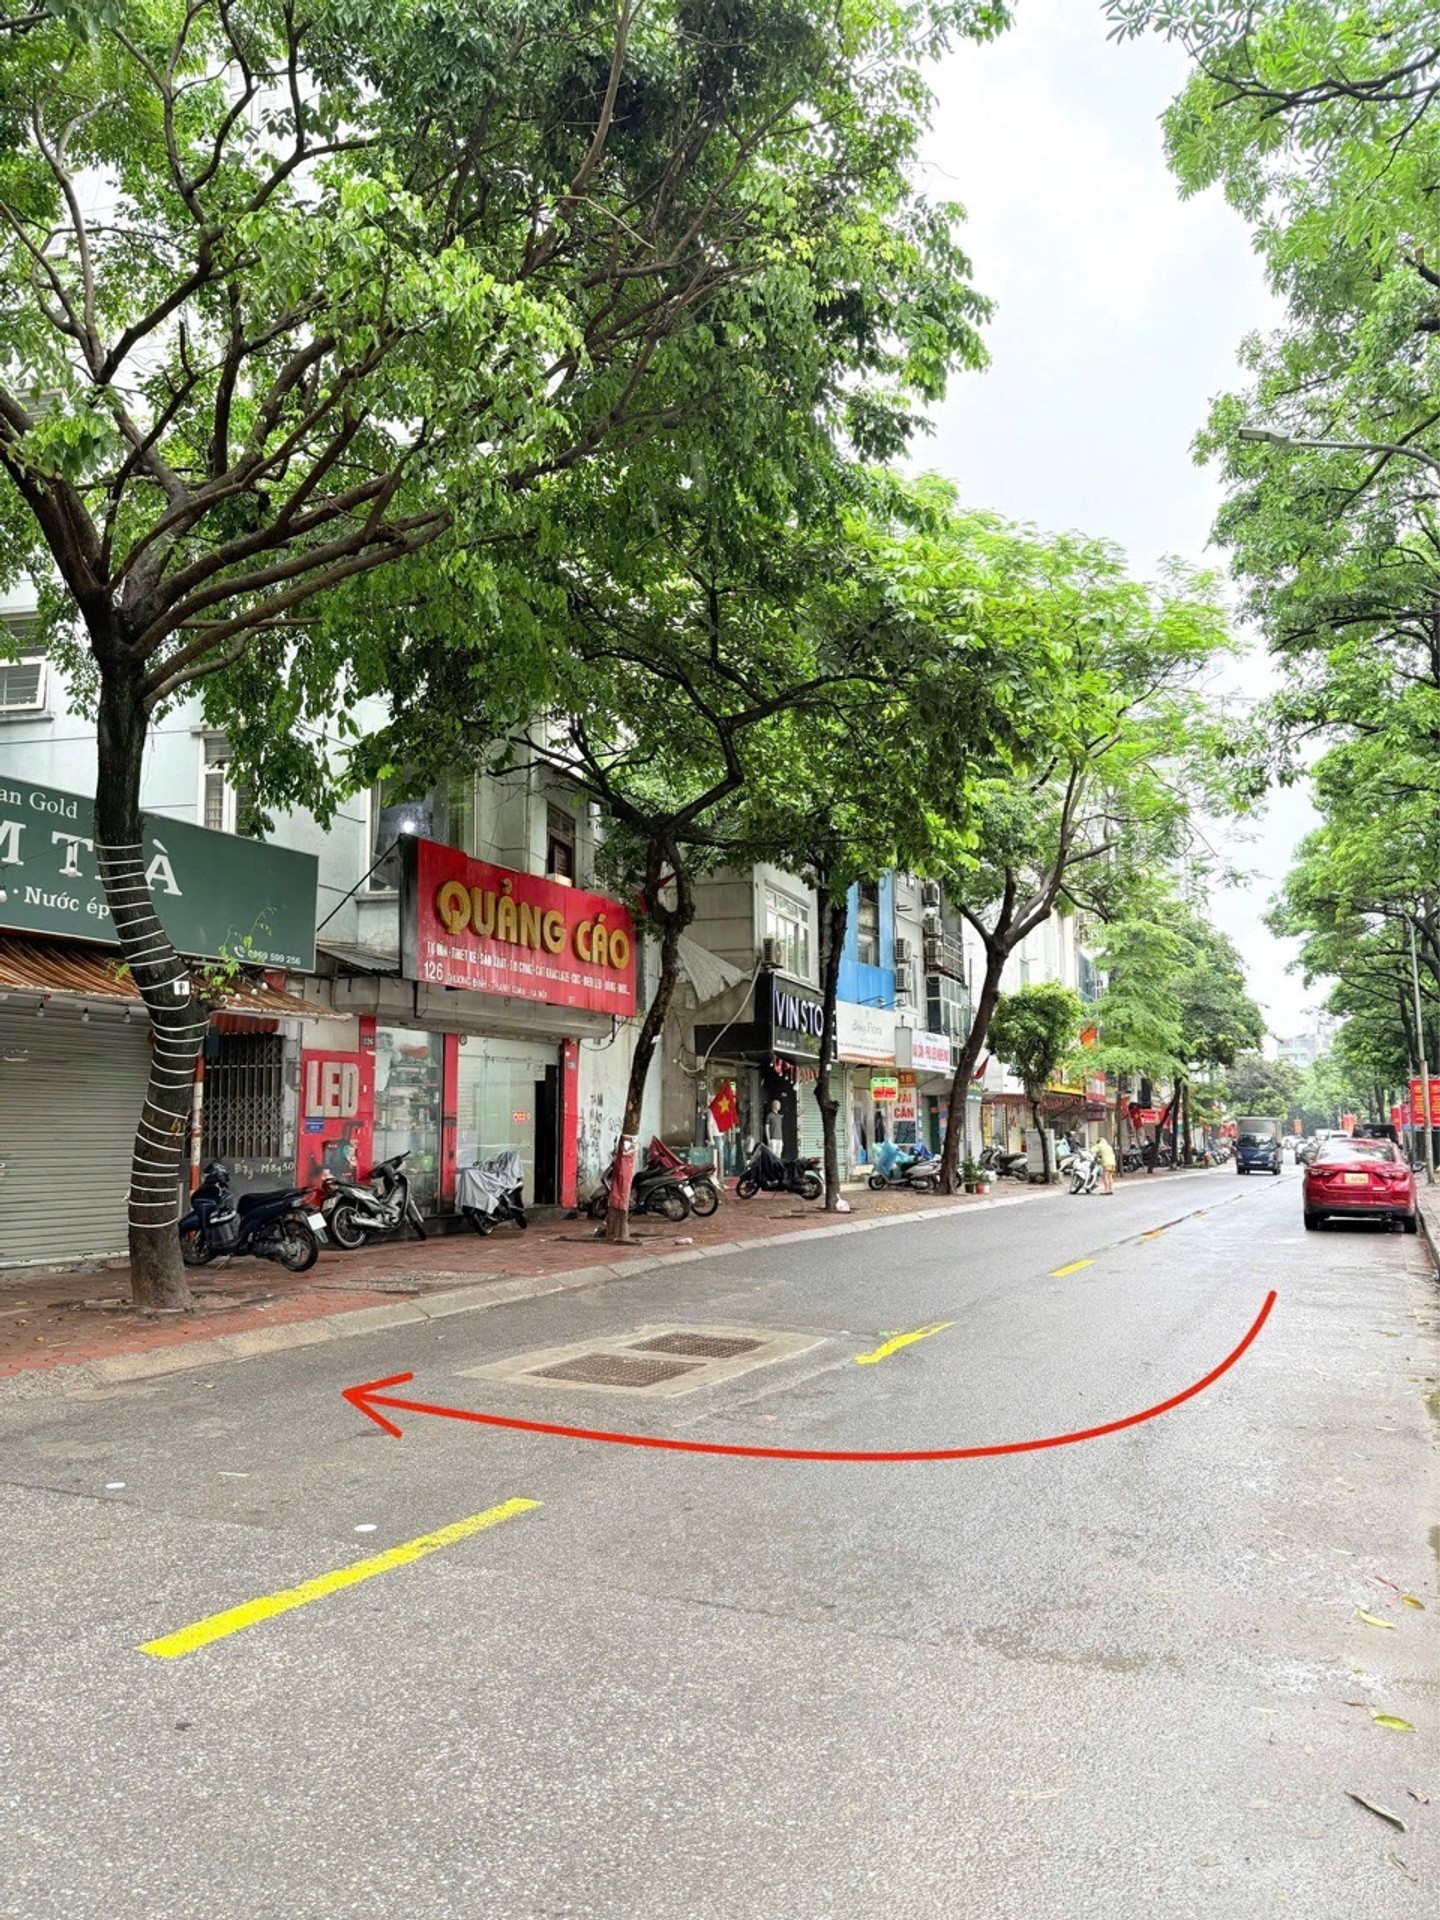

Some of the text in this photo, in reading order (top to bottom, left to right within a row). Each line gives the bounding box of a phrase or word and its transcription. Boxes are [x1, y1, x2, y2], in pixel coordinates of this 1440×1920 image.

[29, 791, 78, 819] Gold
[51, 830, 183, 897] TÀ
[24, 885, 110, 920] Nước ép
[437, 878, 630, 970] QUẢNG CÁO
[423, 960, 444, 982] 126
[775, 990, 799, 1030] VIN
[305, 1060, 360, 1118] LED
